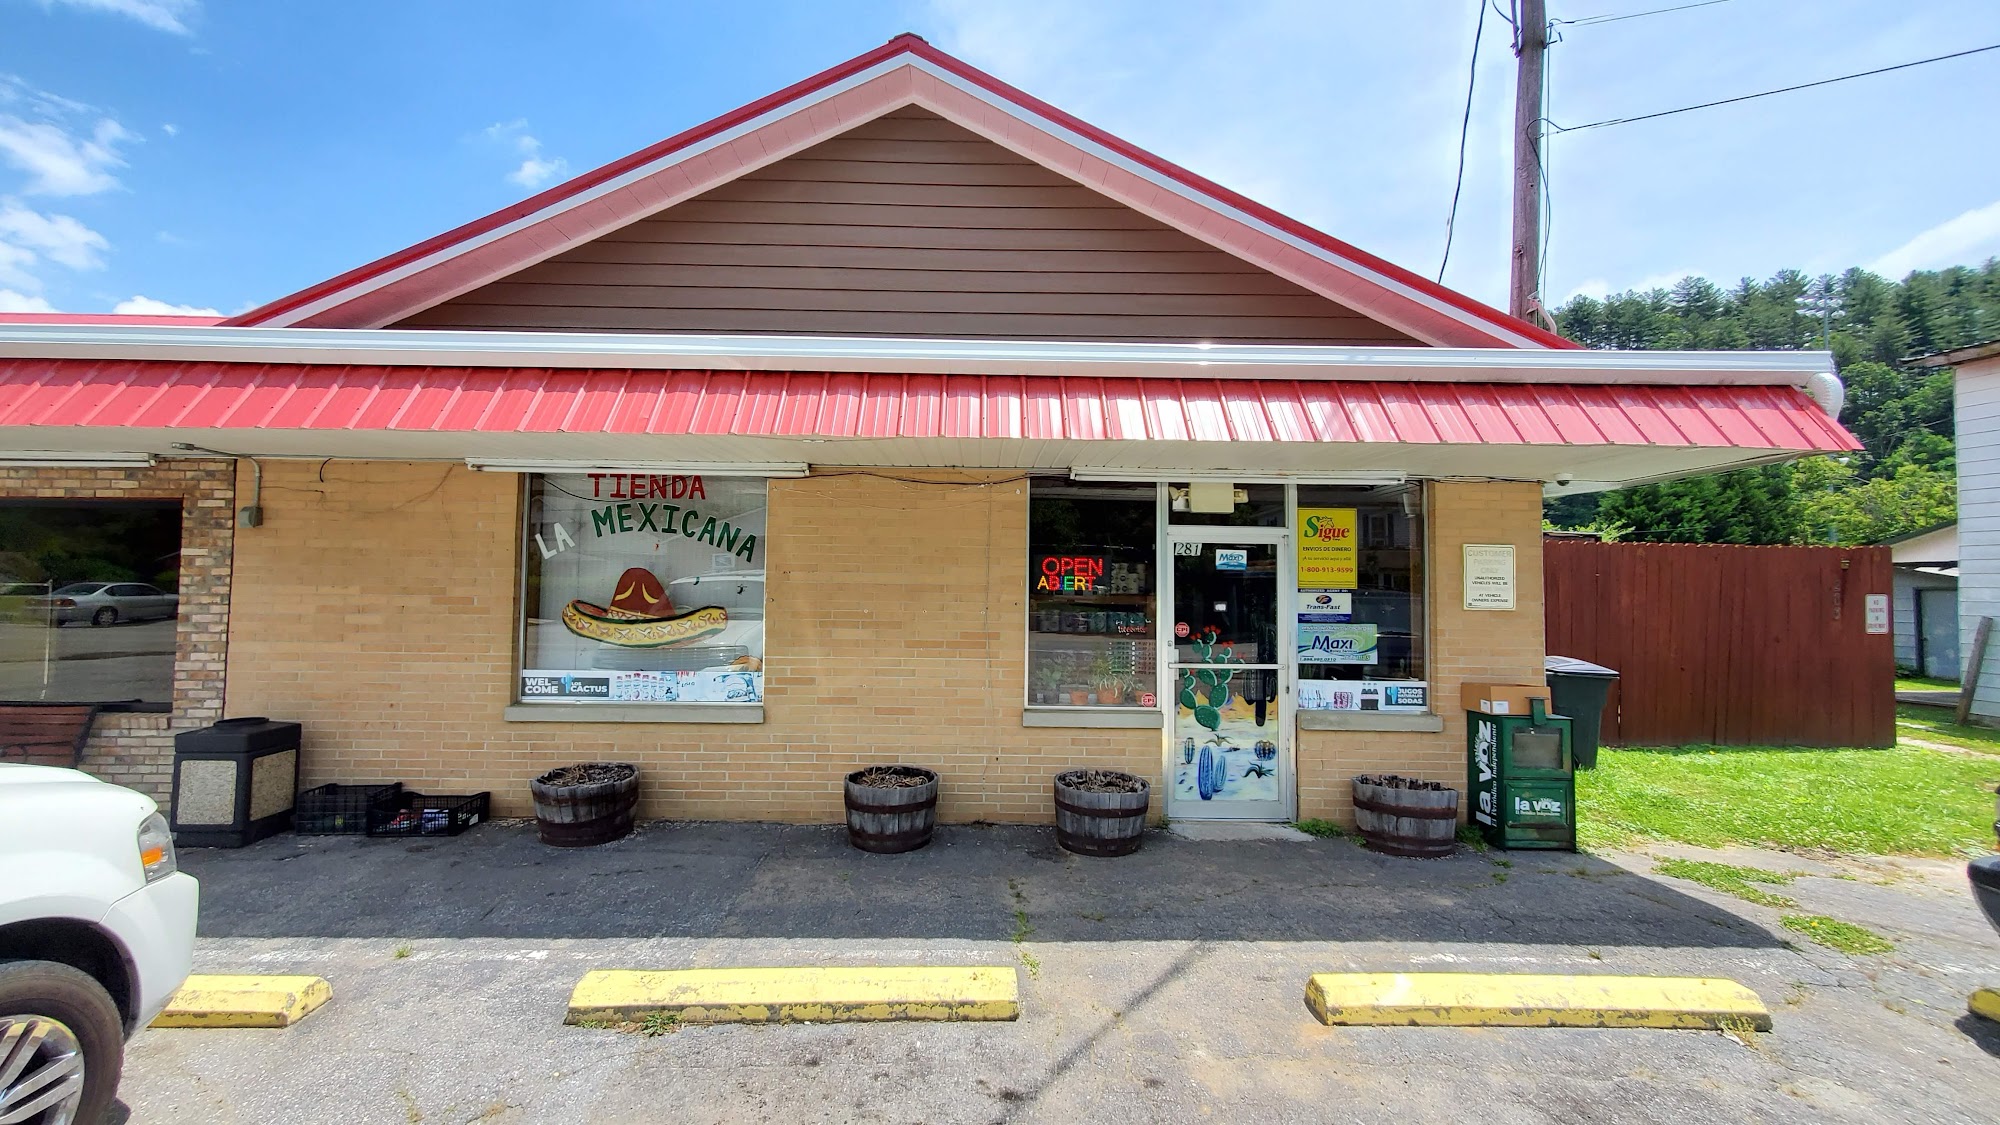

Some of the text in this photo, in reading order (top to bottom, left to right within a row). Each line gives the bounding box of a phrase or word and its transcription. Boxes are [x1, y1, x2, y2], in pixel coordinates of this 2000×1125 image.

[587, 473, 706, 500] TIENDA
[591, 502, 757, 563] MEXICANA
[1304, 516, 1350, 542] Sigue
[534, 522, 575, 560] LA
[1176, 543, 1200, 555] 281
[1041, 557, 1103, 576] OPEN
[1311, 635, 1353, 649] Maxi
[525, 686, 559, 694] COME
[570, 685, 608, 693] CACTUS
[1476, 720, 1492, 826] la voz
[1515, 796, 1561, 812] la voz
